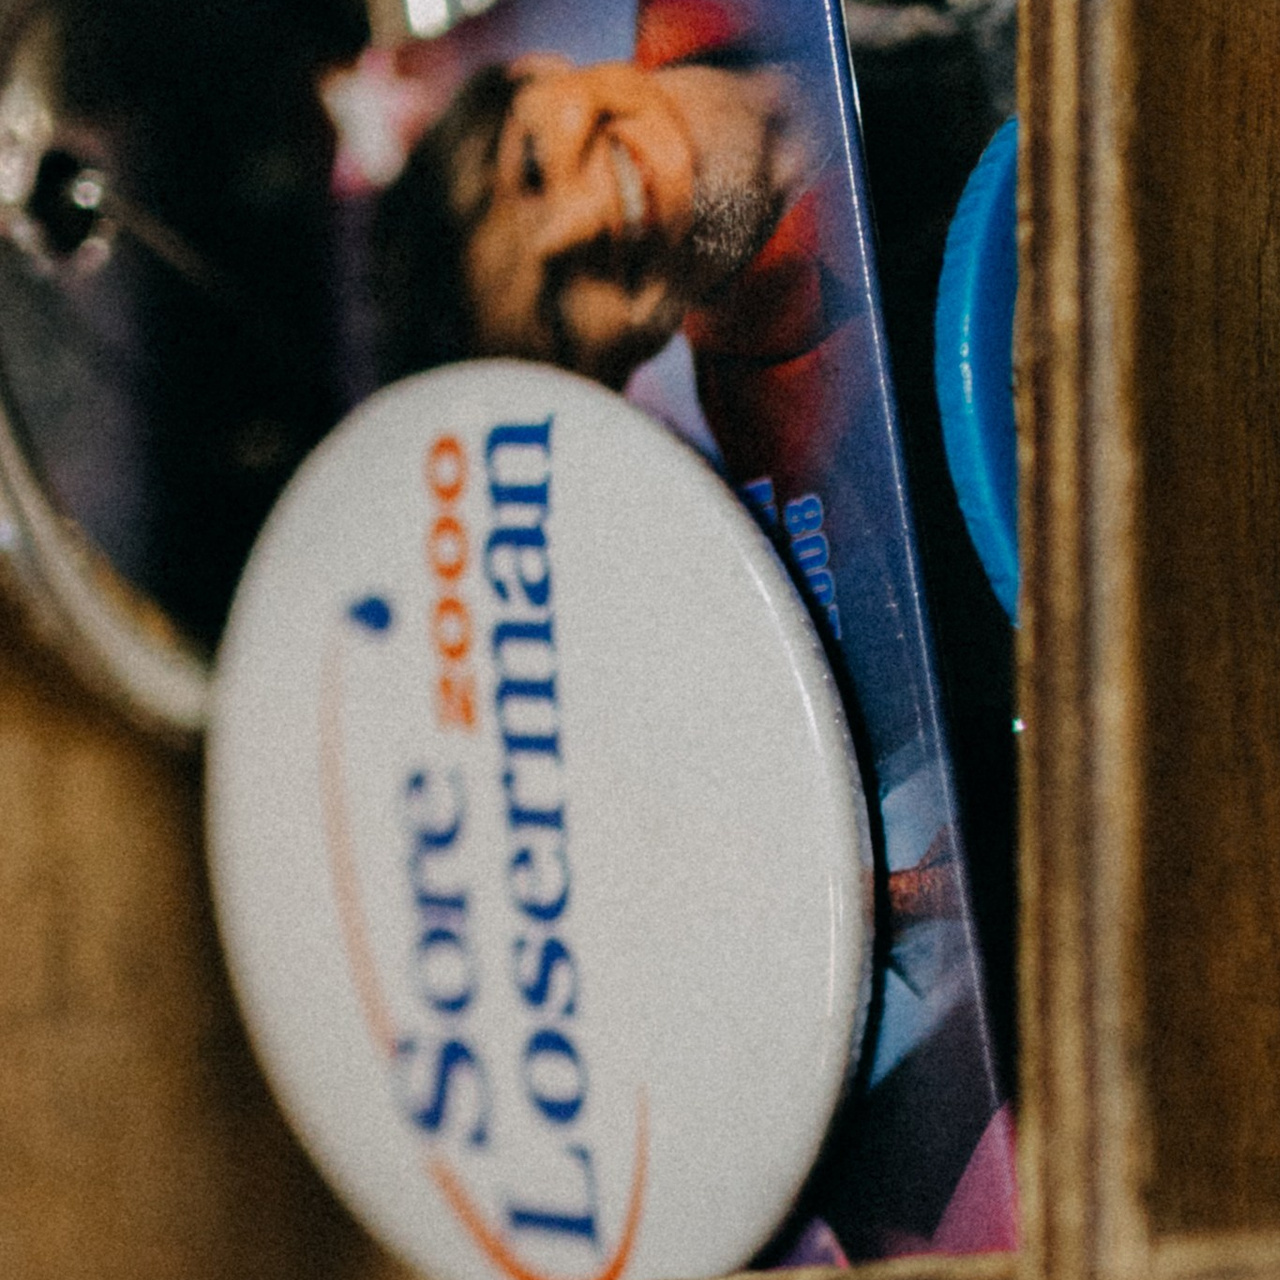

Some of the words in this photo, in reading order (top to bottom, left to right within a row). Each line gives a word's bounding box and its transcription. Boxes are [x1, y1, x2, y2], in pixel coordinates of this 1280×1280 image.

[425, 435, 479, 731] 2000
[402, 766, 492, 1148] Sore
[482, 412, 602, 1252] Loserman
